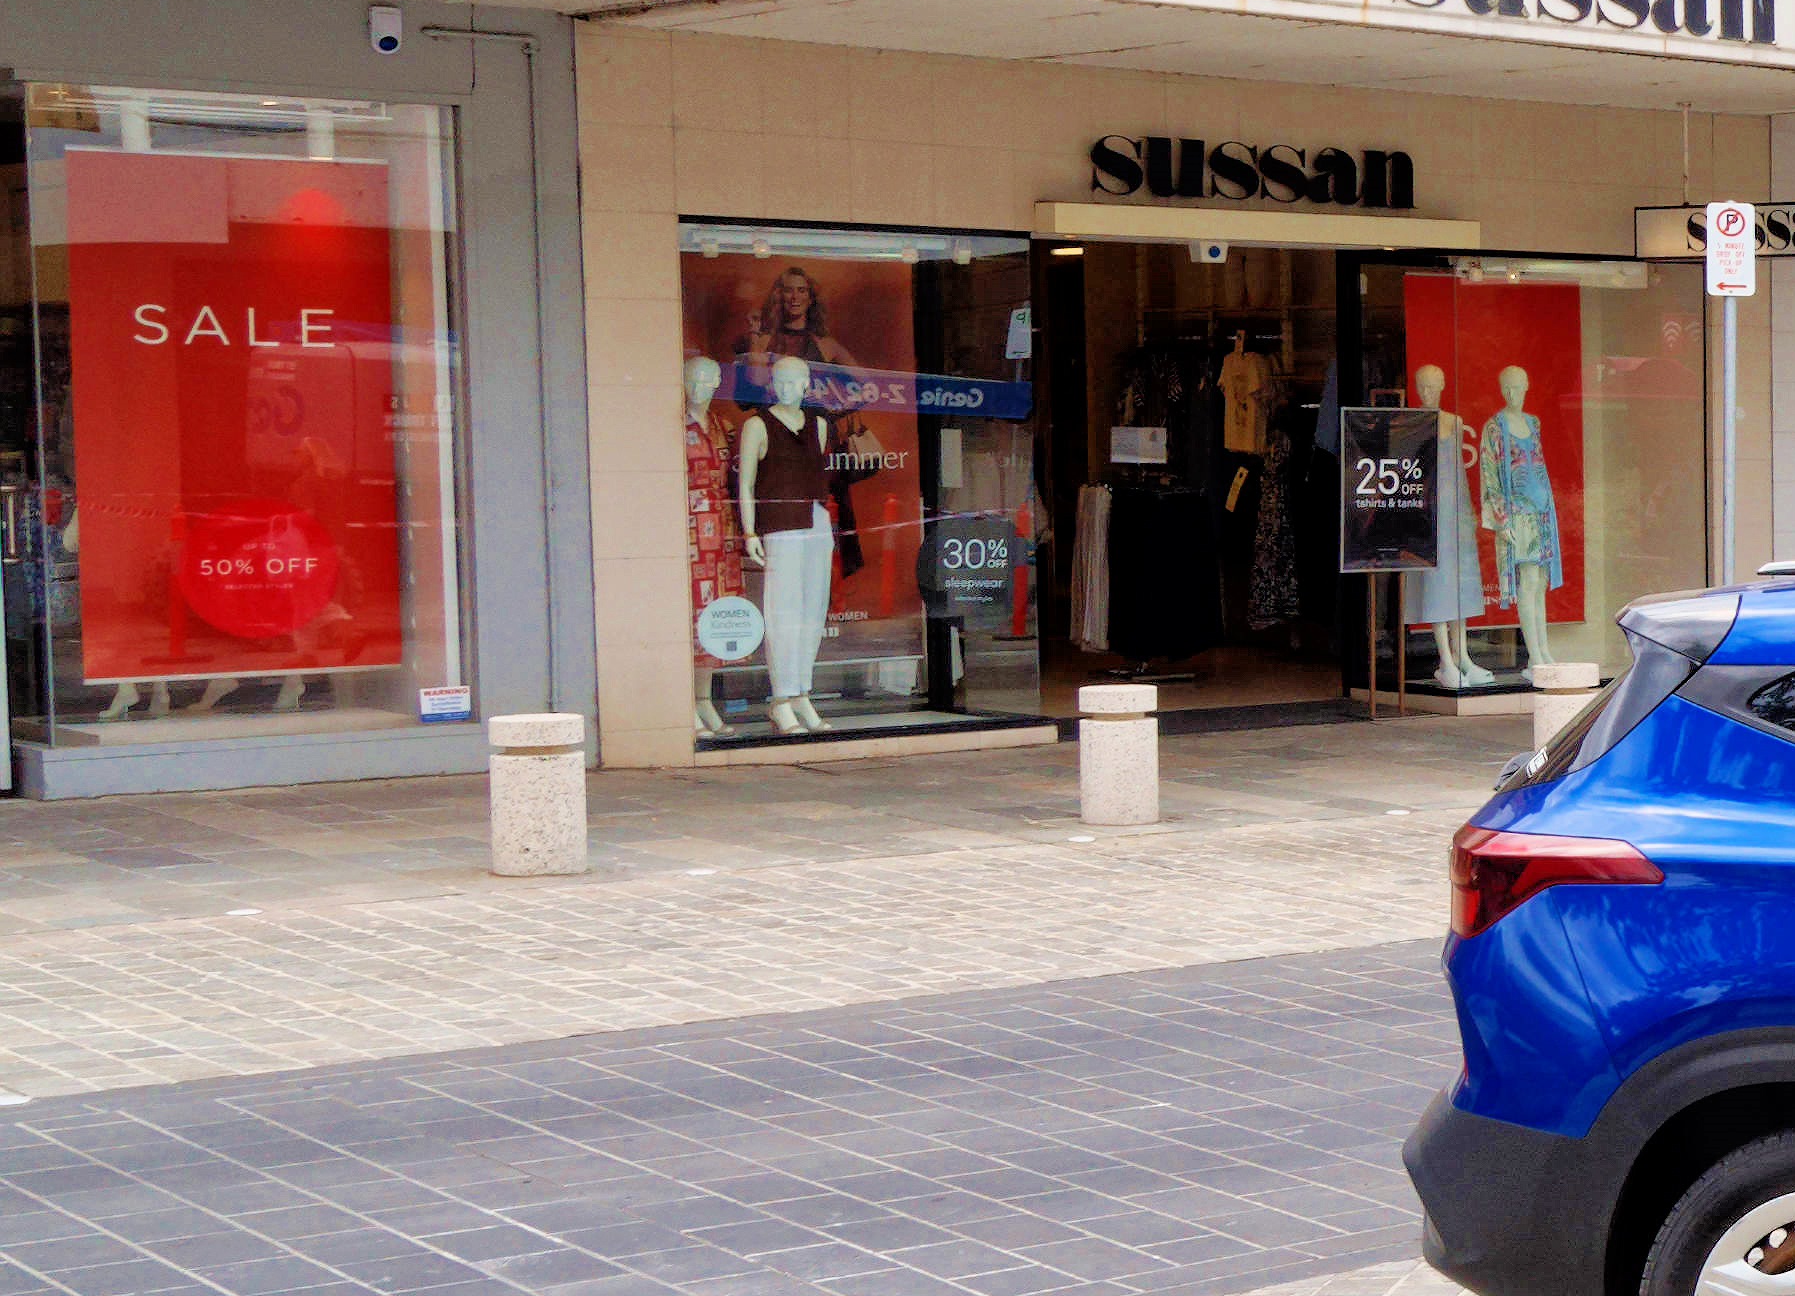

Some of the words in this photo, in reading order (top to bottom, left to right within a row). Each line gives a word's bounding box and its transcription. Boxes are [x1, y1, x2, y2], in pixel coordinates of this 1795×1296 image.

[1091, 134, 1416, 209] sussan
[133, 303, 336, 348] SALE
[1355, 457, 1424, 496] 25%
[1401, 484, 1424, 495] OFF
[200, 558, 255, 576] 50%
[266, 557, 319, 575] OFF
[943, 538, 1008, 569] 30%
[987, 559, 1008, 569] OFF
